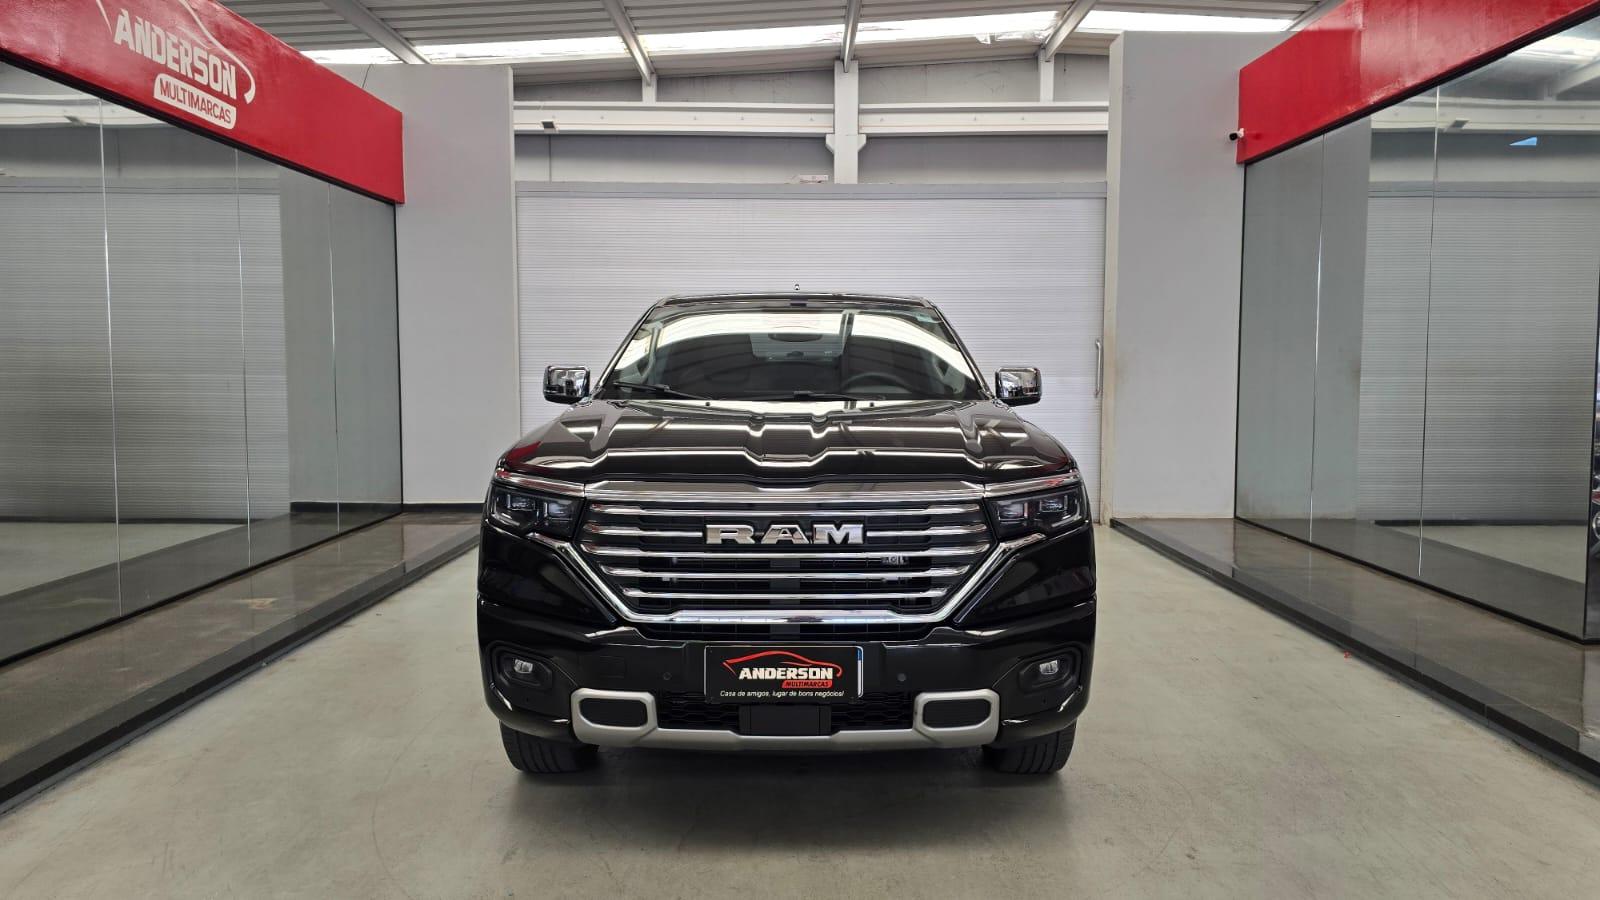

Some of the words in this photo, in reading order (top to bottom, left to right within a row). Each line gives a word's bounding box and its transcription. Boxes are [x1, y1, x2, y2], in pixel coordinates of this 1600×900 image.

[113, 8, 237, 100] ANDERSON
[159, 78, 232, 124] MULTIMARCAS
[706, 524, 864, 545] RAM
[738, 667, 833, 680] ANDERSON
[772, 690, 789, 698] lugar
[814, 690, 845, 698] negócios!
